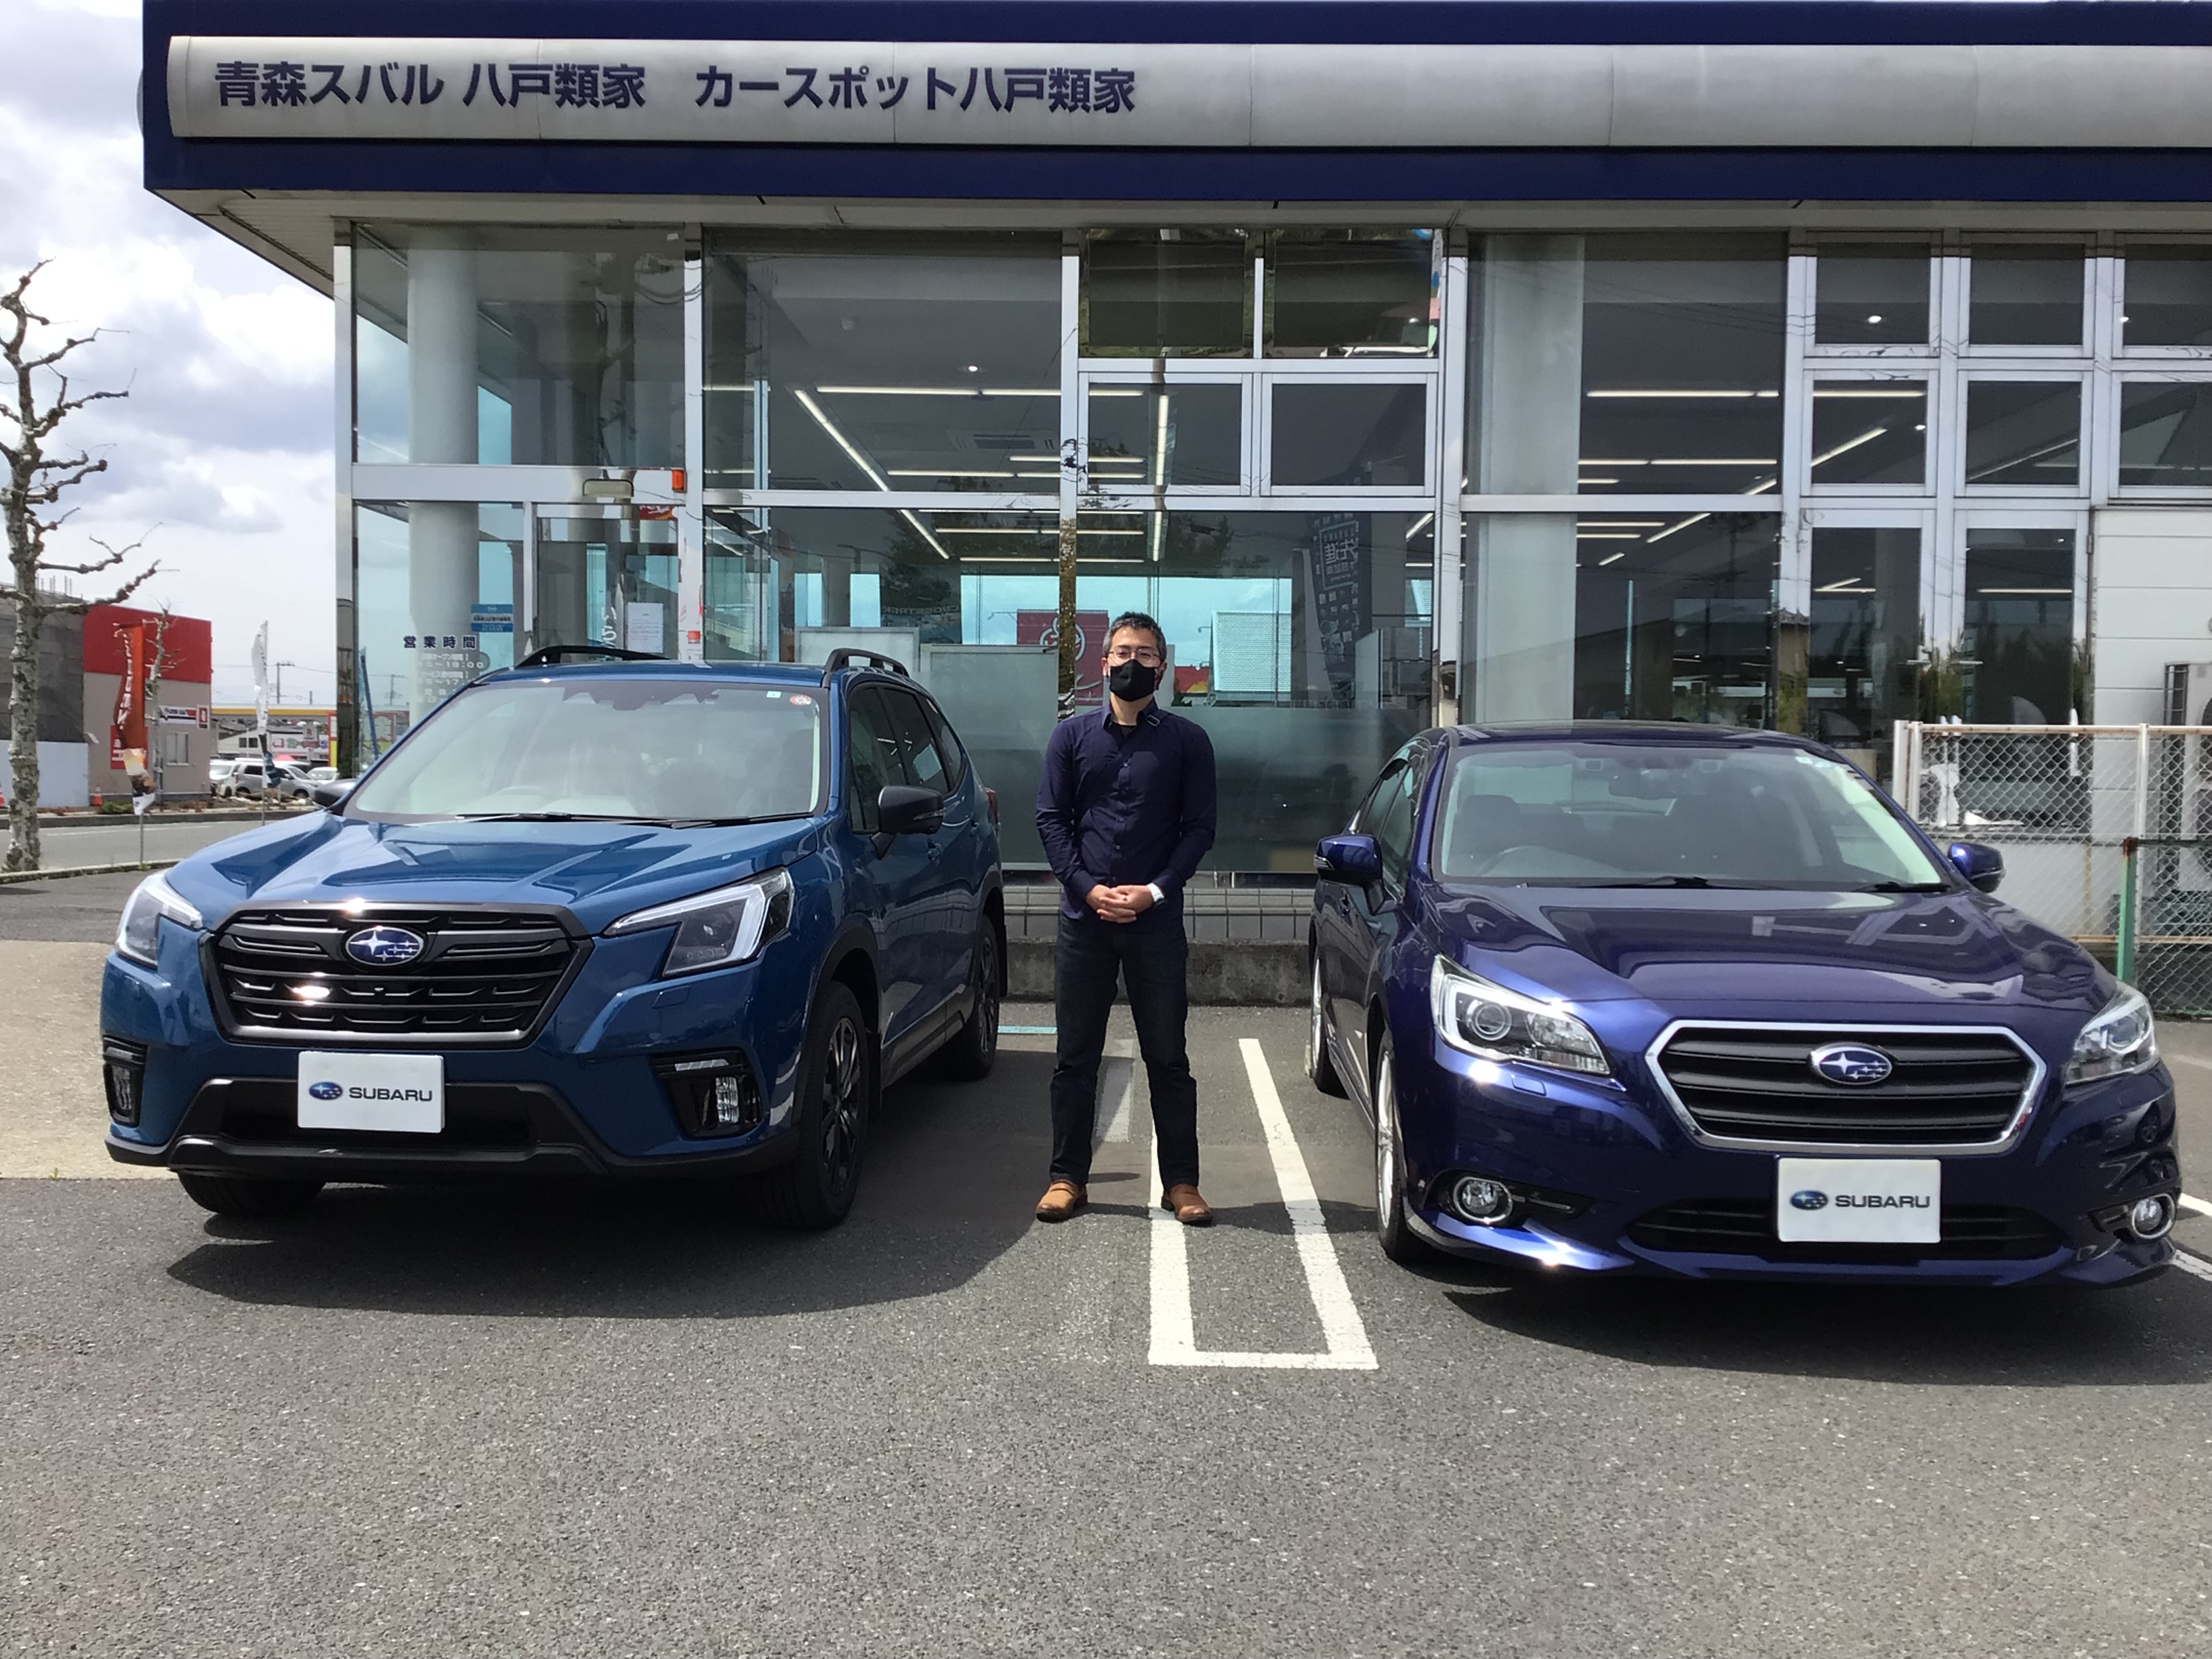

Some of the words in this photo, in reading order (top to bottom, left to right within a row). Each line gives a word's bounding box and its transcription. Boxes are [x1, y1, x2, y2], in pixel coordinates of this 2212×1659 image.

[214, 60, 444, 107] 青森スバル
[462, 62, 646, 109] 八戸類家
[695, 65, 1136, 113] カースポット八戸類家
[403, 635, 476, 649] 営業時間
[349, 1087, 433, 1102] SUBARU
[1835, 1195, 1931, 1208] SUBARU
